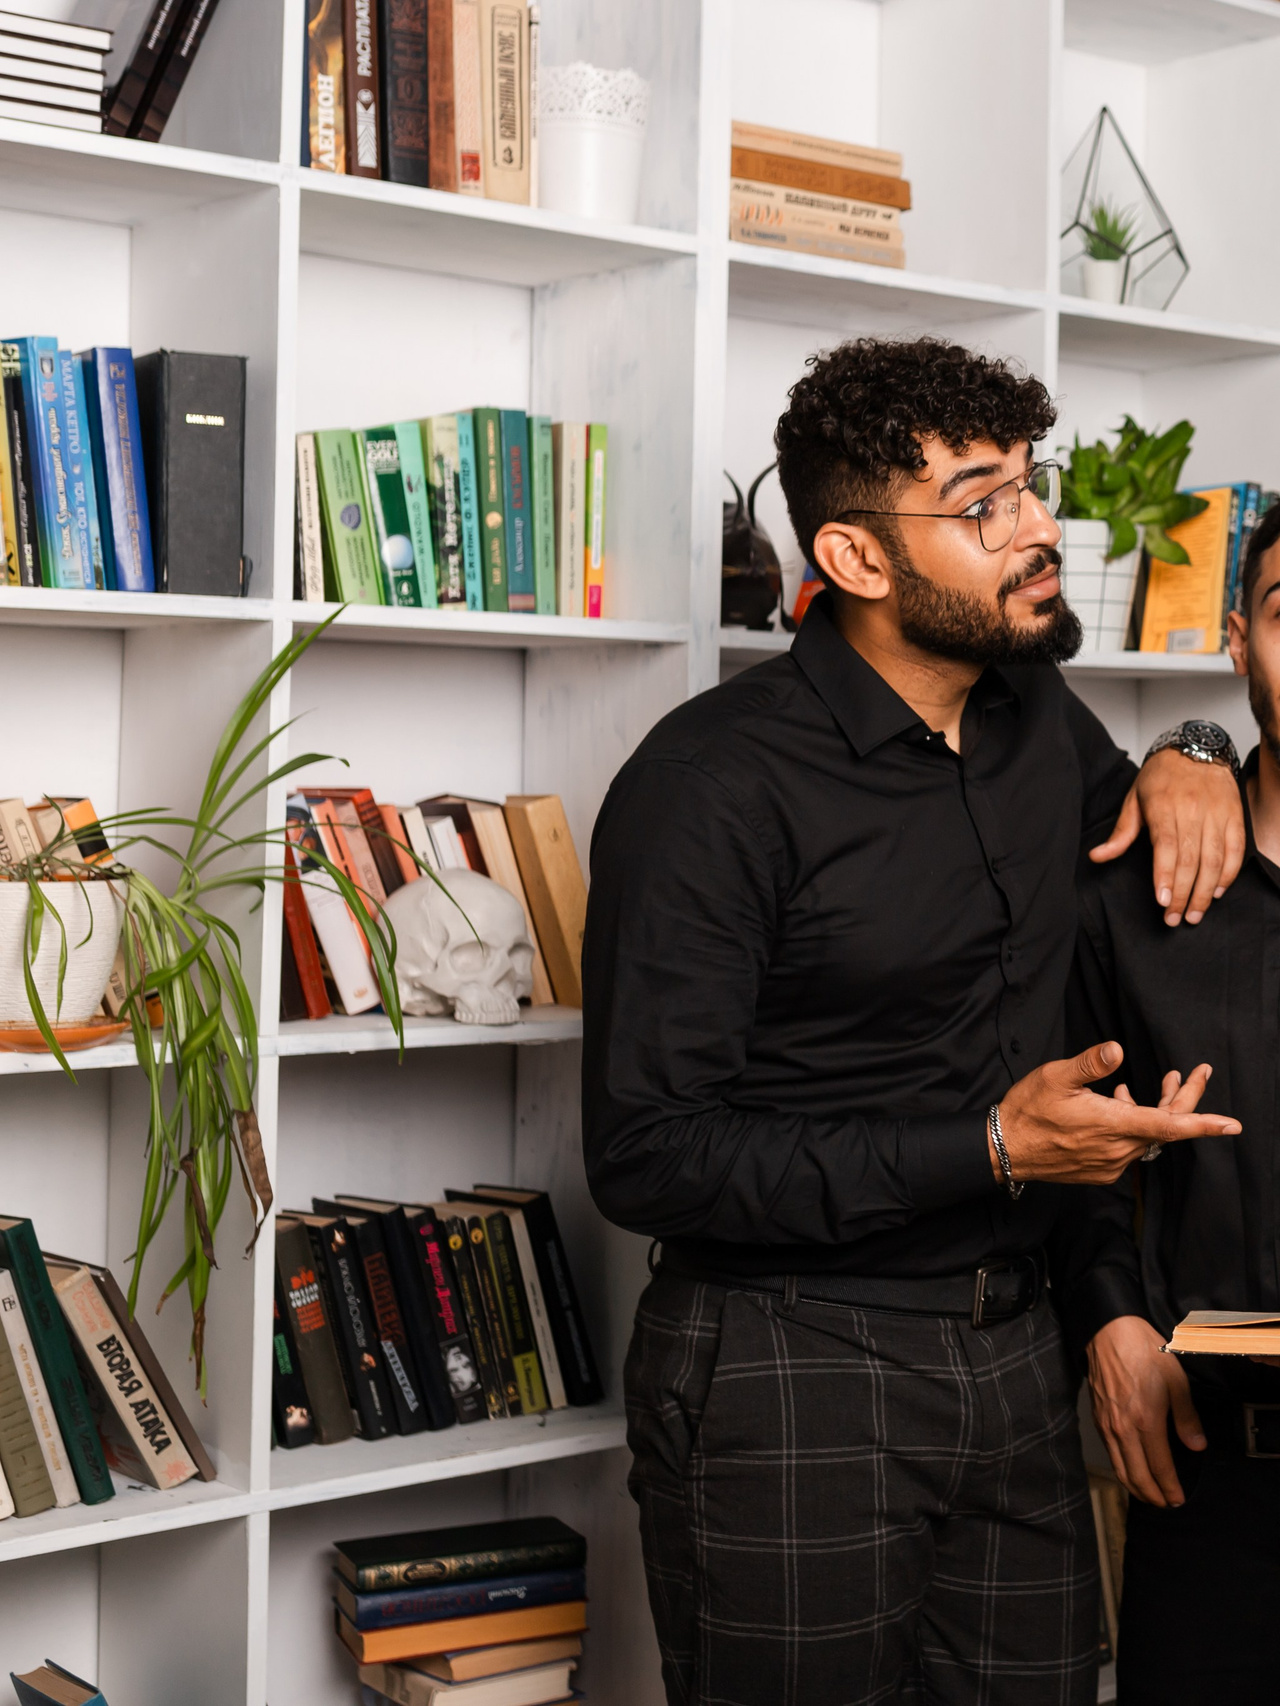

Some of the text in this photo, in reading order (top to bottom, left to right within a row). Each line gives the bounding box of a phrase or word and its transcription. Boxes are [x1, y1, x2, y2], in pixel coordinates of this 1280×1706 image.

[355, 0, 373, 78] РАСПЛАТ
[61, 359, 77, 407] МАРТА
[97, 1333, 172, 1455] ВТОРАЯ АТАКА
